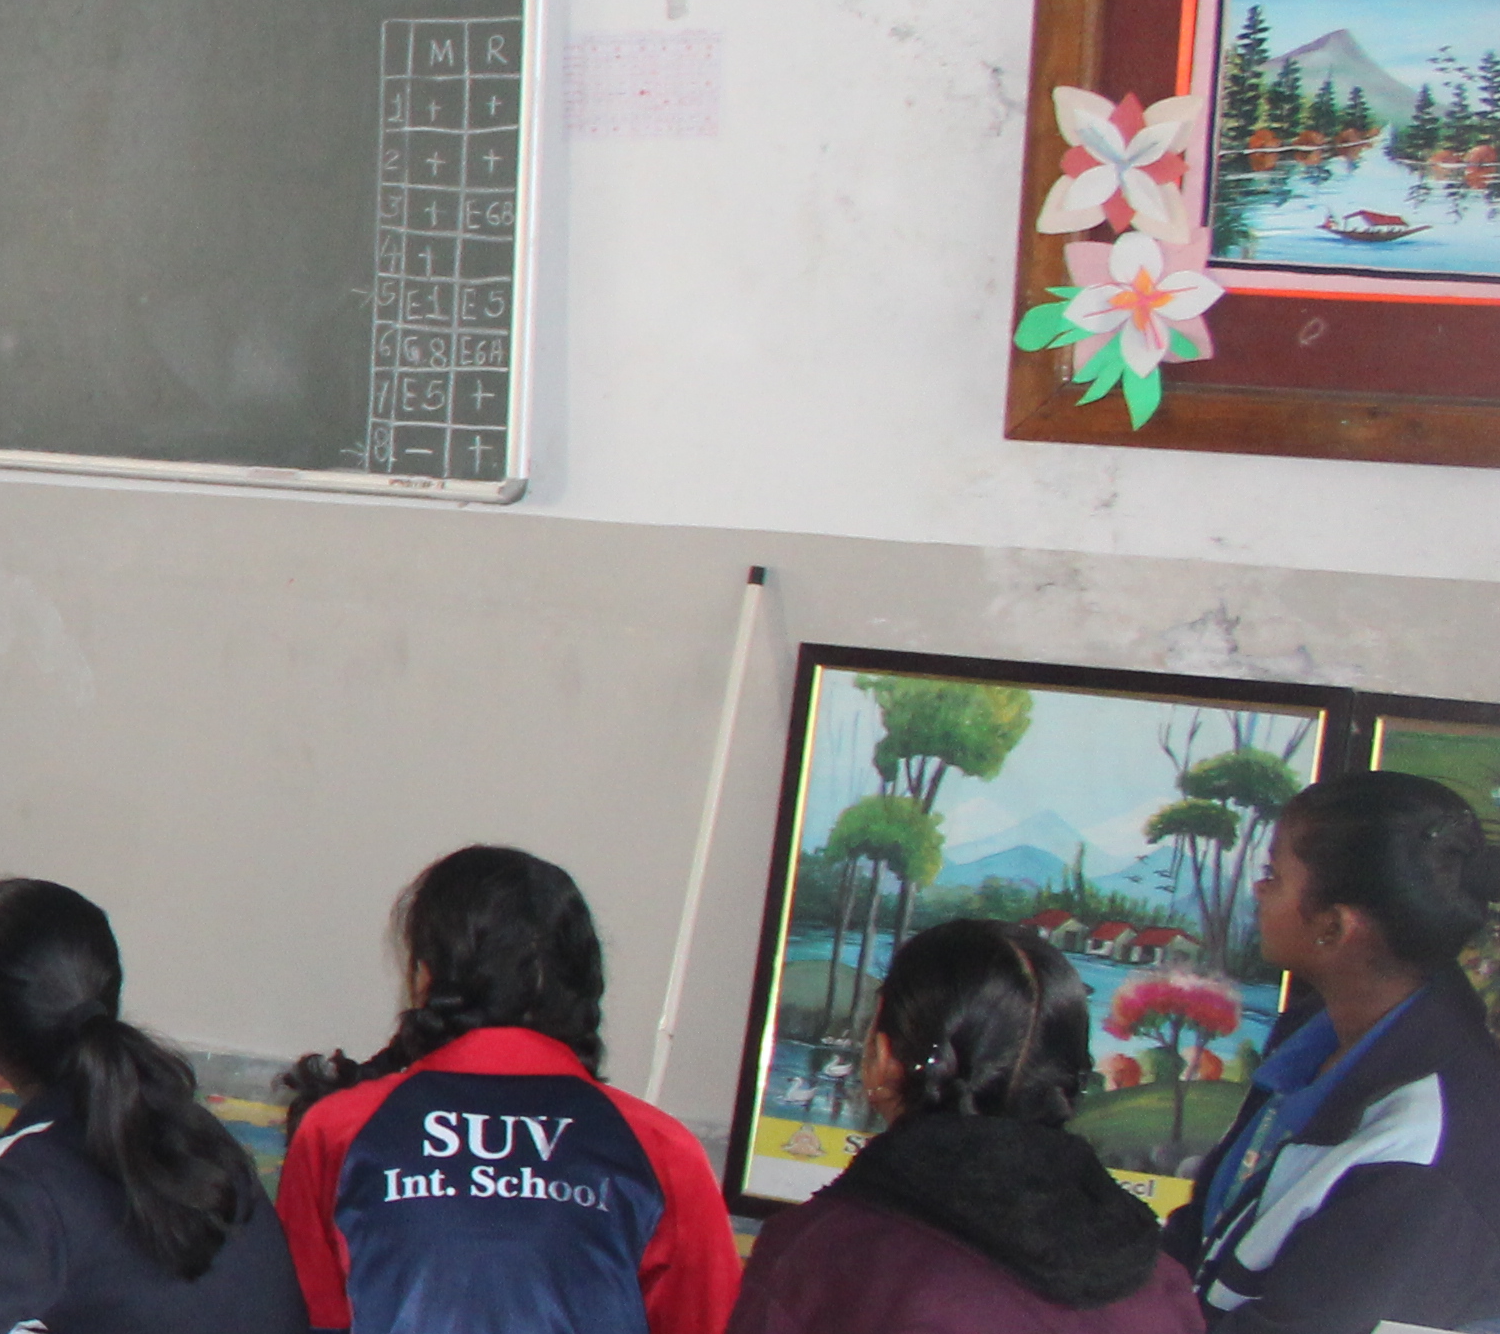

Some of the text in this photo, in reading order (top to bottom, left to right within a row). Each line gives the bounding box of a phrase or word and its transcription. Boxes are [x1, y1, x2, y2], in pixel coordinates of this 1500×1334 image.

[430, 34, 508, 67] M R
[388, 93, 404, 122] 1
[384, 149, 399, 170] 2
[381, 196, 402, 217] 3
[380, 235, 401, 272] 4
[377, 282, 396, 306] 5
[379, 329, 396, 357] 6
[422, 1109, 575, 1161] SUV
[384, 1165, 610, 1213] Int. School
